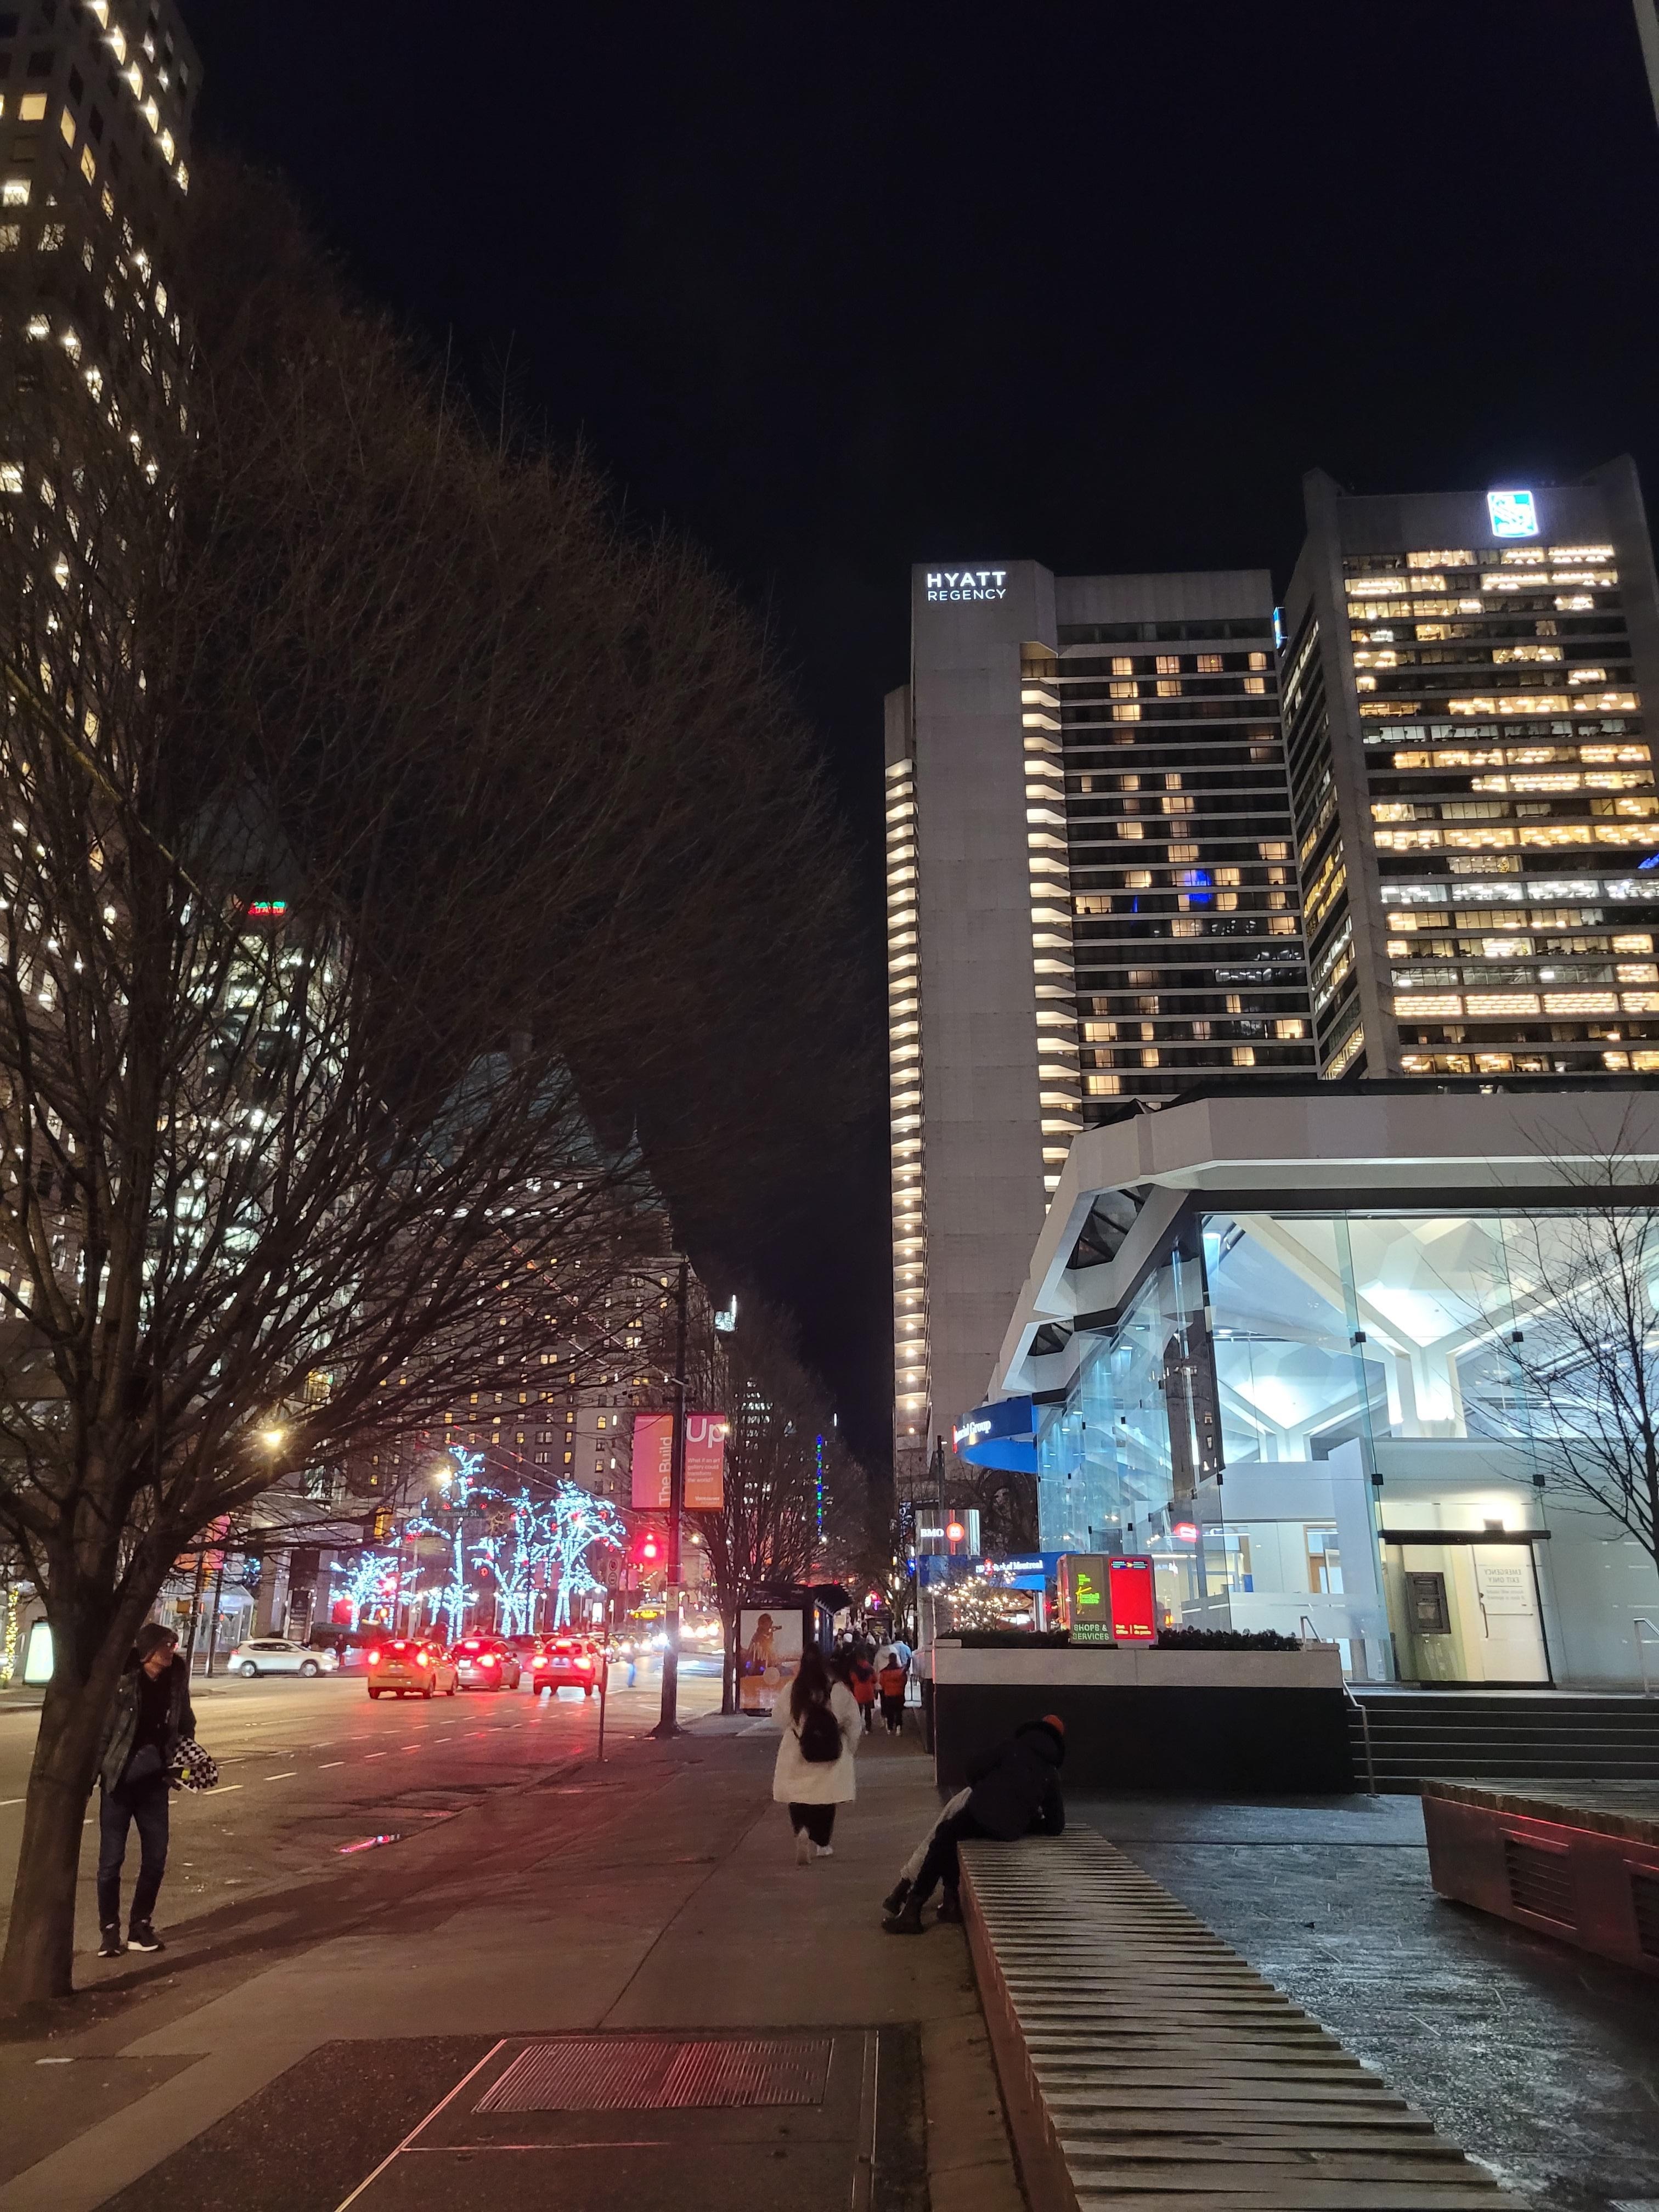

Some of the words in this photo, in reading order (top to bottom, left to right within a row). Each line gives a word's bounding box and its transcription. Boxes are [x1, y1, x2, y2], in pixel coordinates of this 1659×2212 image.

[927, 572, 1006, 588] HYATT
[928, 589, 1006, 601] REGENCY
[686, 1418, 725, 1448] Up
[659, 1437, 672, 1473] Build
[659, 1476, 671, 1505] The
[920, 1528, 944, 1537] BMO
